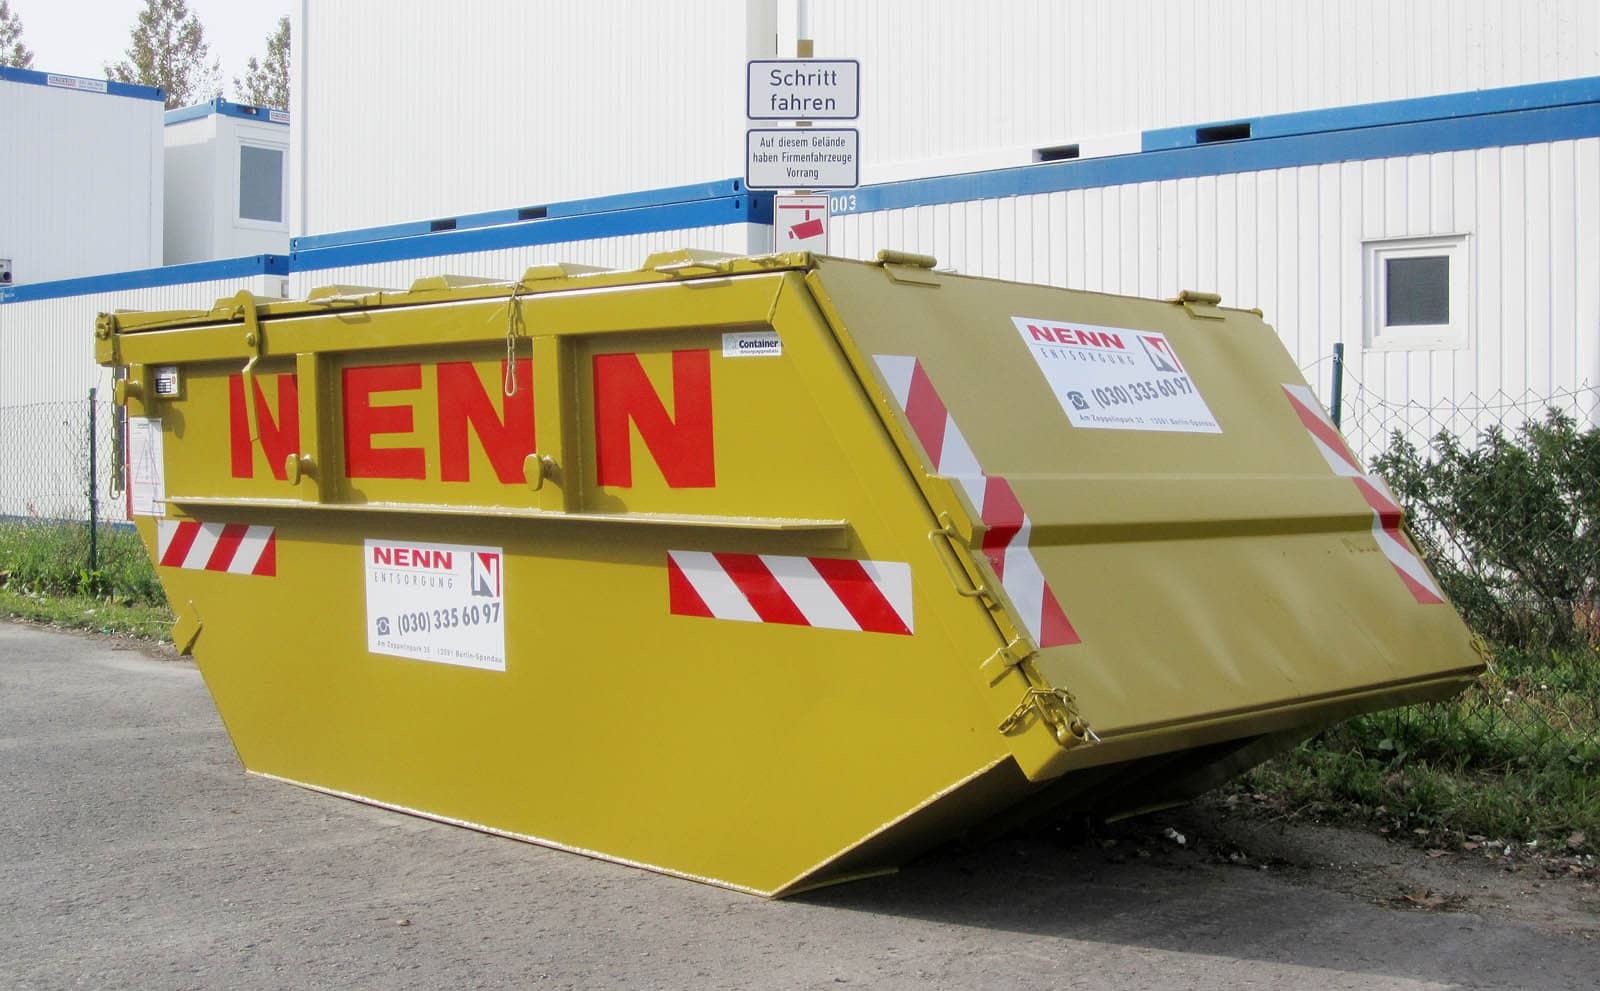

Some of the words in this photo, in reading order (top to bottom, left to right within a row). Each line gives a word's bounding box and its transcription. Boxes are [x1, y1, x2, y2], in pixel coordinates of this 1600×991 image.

[770, 69, 837, 87] Schritt
[770, 94, 836, 111] fahren
[760, 137, 774, 147] Auf
[778, 137, 808, 147] diesem
[812, 137, 846, 147] Gelände
[753, 152, 778, 163] haben
[782, 152, 852, 165] Firmenfahrzeuge
[786, 168, 819, 180] Vorrang
[831, 195, 857, 213] 003
[738, 339, 779, 349] Container
[1027, 324, 1125, 349] NENN
[1041, 348, 1135, 366] ENTSORGUNG
[1091, 384, 1134, 409] (030)
[228, 348, 716, 488] NENN
[373, 546, 453, 570] NENN
[374, 571, 454, 589] ENTSORGUNG
[397, 611, 431, 637] (030)
[433, 607, 460, 630] 335
[462, 605, 480, 626] 60
[482, 602, 500, 624] 97
